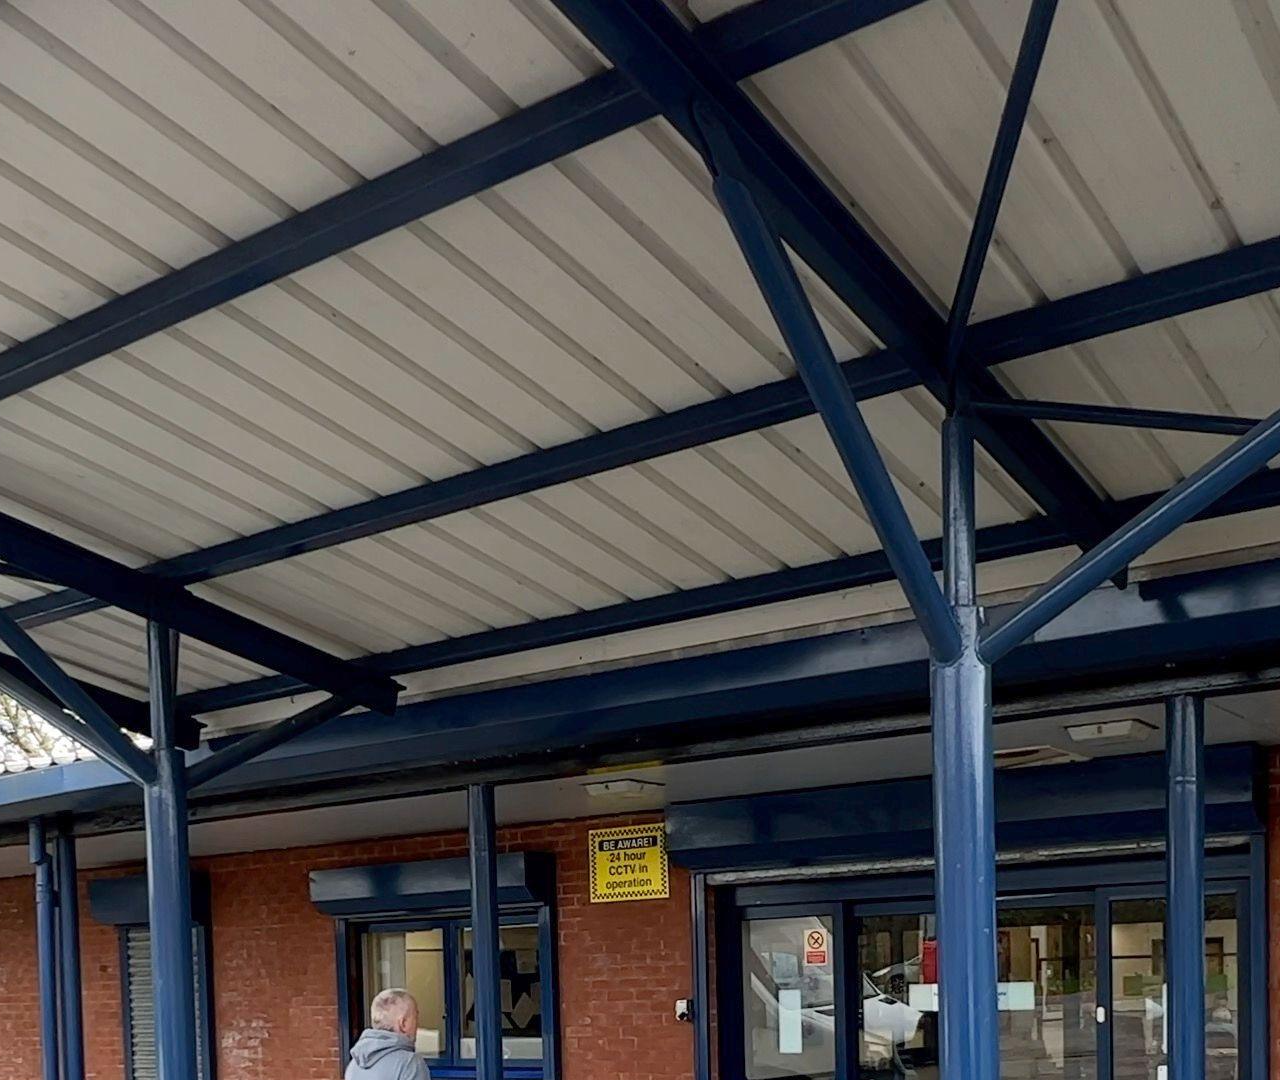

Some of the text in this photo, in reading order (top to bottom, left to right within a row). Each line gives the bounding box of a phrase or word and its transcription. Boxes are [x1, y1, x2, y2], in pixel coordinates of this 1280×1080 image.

[603, 838, 653, 850] BE AWARE!
[609, 851, 646, 863] 24 hour
[608, 864, 648, 876] CCTV in
[605, 878, 652, 891] operation
